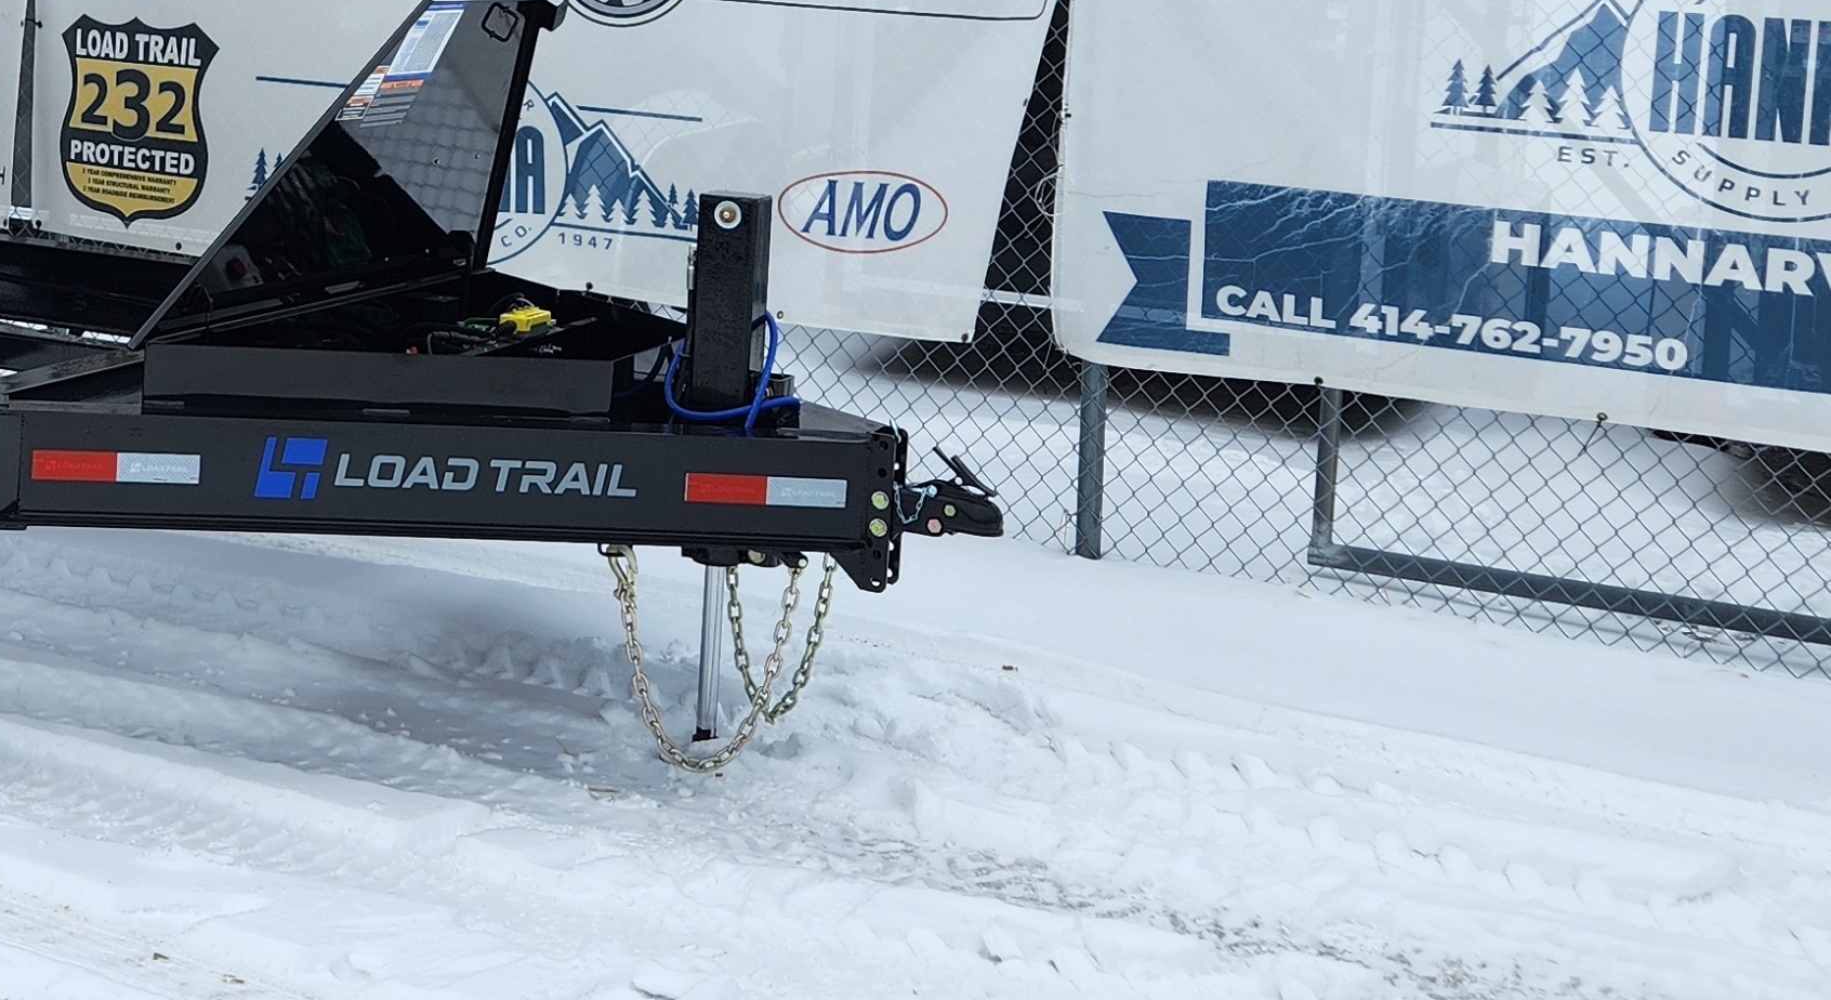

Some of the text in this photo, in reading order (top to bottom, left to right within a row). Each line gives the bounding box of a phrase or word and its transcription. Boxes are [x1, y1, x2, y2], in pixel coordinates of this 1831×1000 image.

[75, 27, 202, 67] LOAD TRAIL
[80, 68, 186, 141] 232
[69, 139, 196, 176] PROTECTED
[1556, 145, 1630, 168] EST.
[101, 170, 146, 183] COMPREHENSIVE
[147, 176, 177, 186] WARRANTY
[106, 179, 139, 191] STRUCTURAL
[141, 185, 171, 195] WARRANTY
[1671, 149, 1810, 207] SUPPLY
[800, 178, 922, 242] AMO
[500, 225, 533, 248] CO.
[557, 232, 613, 250] 1947
[1490, 220, 1831, 297] HANNAR
[1215, 284, 1689, 371] CALL 414-762-7950
[334, 452, 638, 498] LOAD TRAIL
